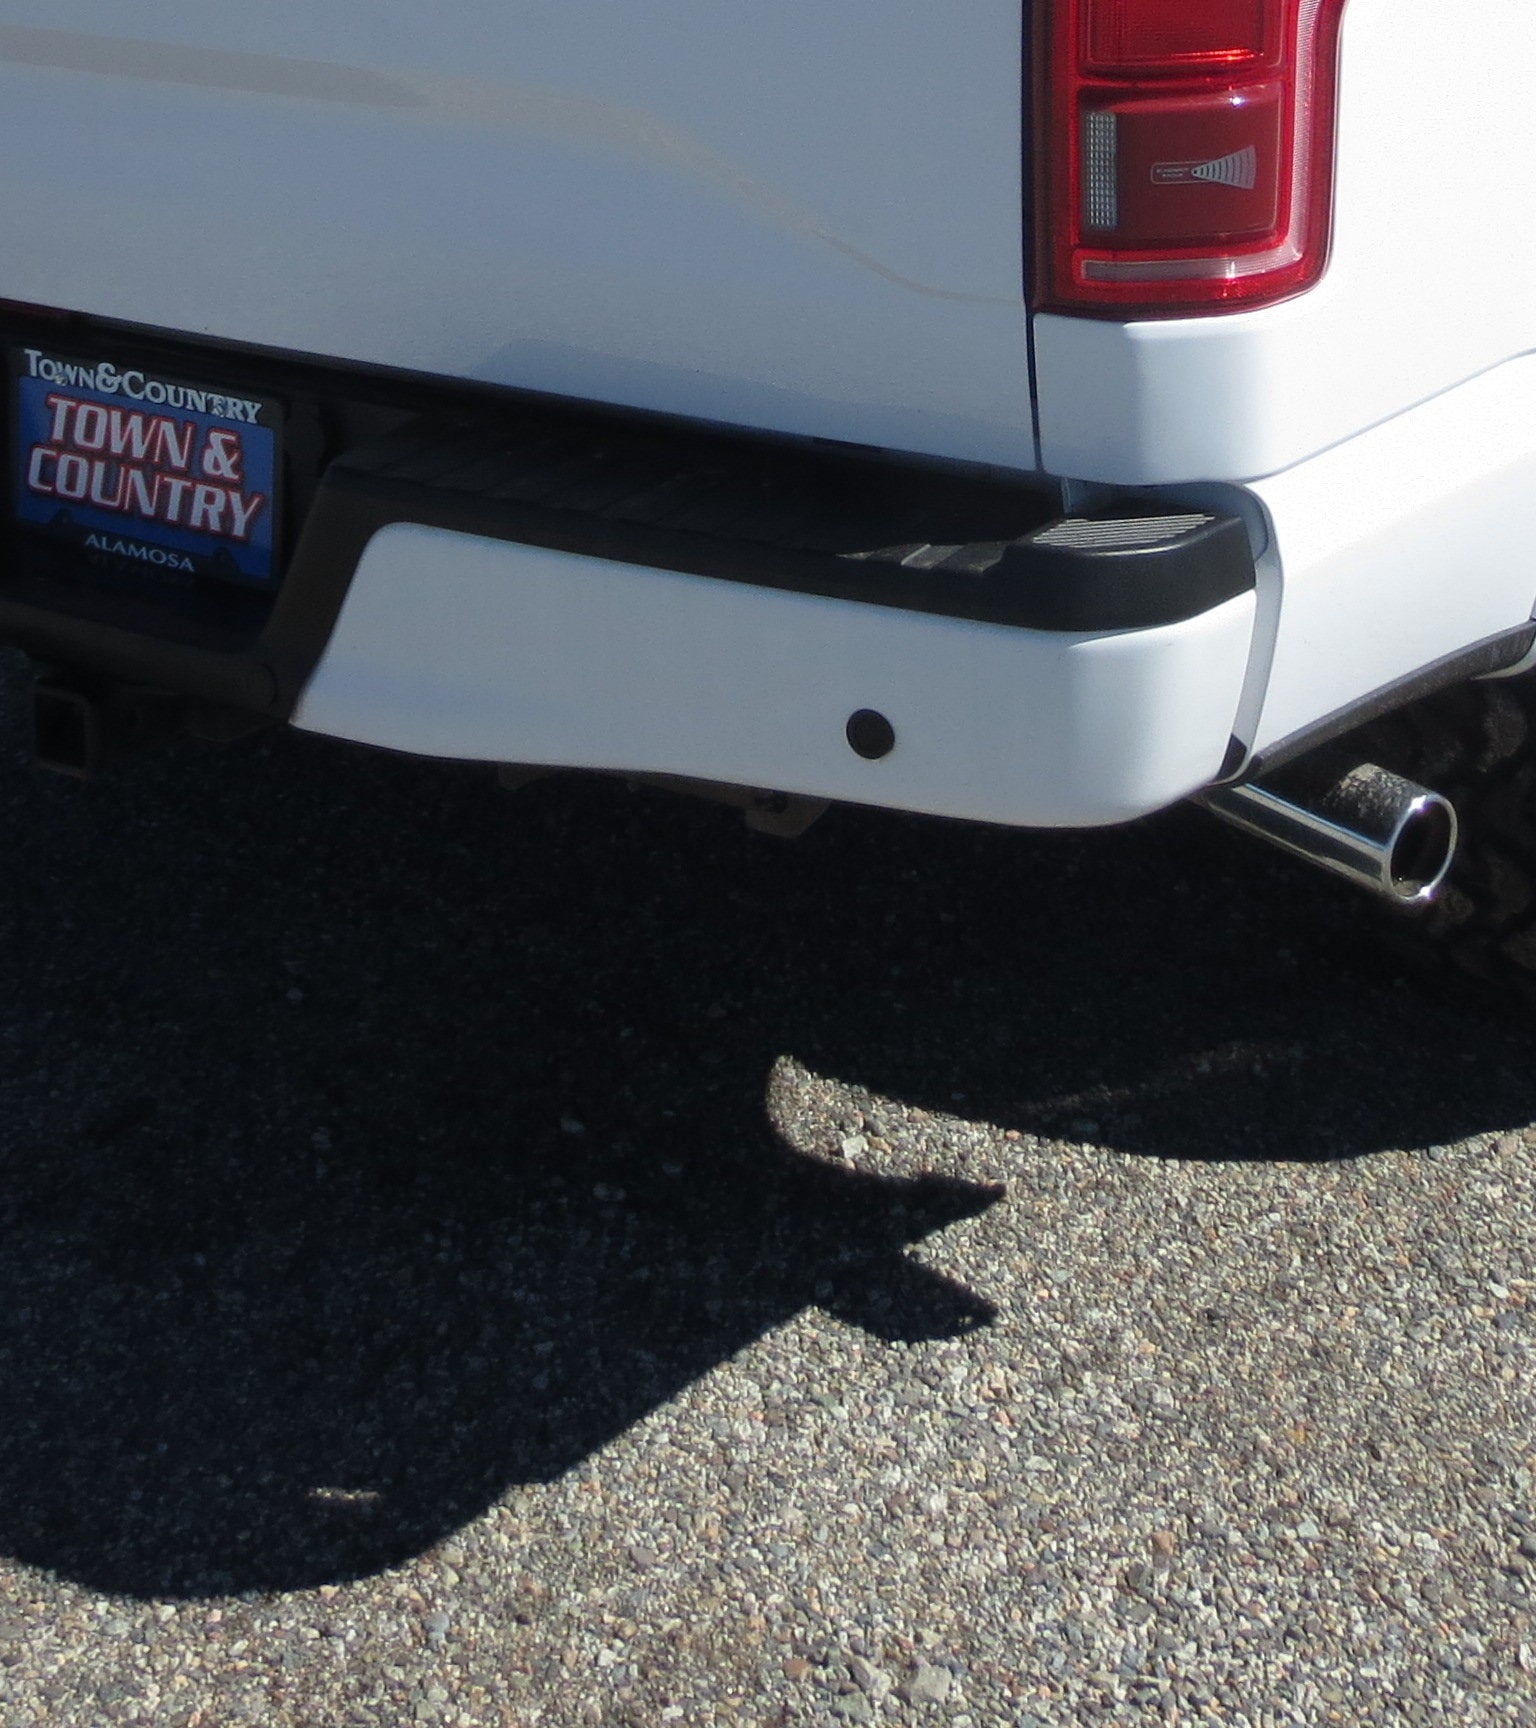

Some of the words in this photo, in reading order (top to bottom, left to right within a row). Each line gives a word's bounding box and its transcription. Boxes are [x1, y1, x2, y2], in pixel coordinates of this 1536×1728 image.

[48, 395, 195, 470] TOWN
[202, 430, 240, 481] &
[28, 447, 263, 539] COUNTRY
[85, 534, 195, 572] ALAMOSA
